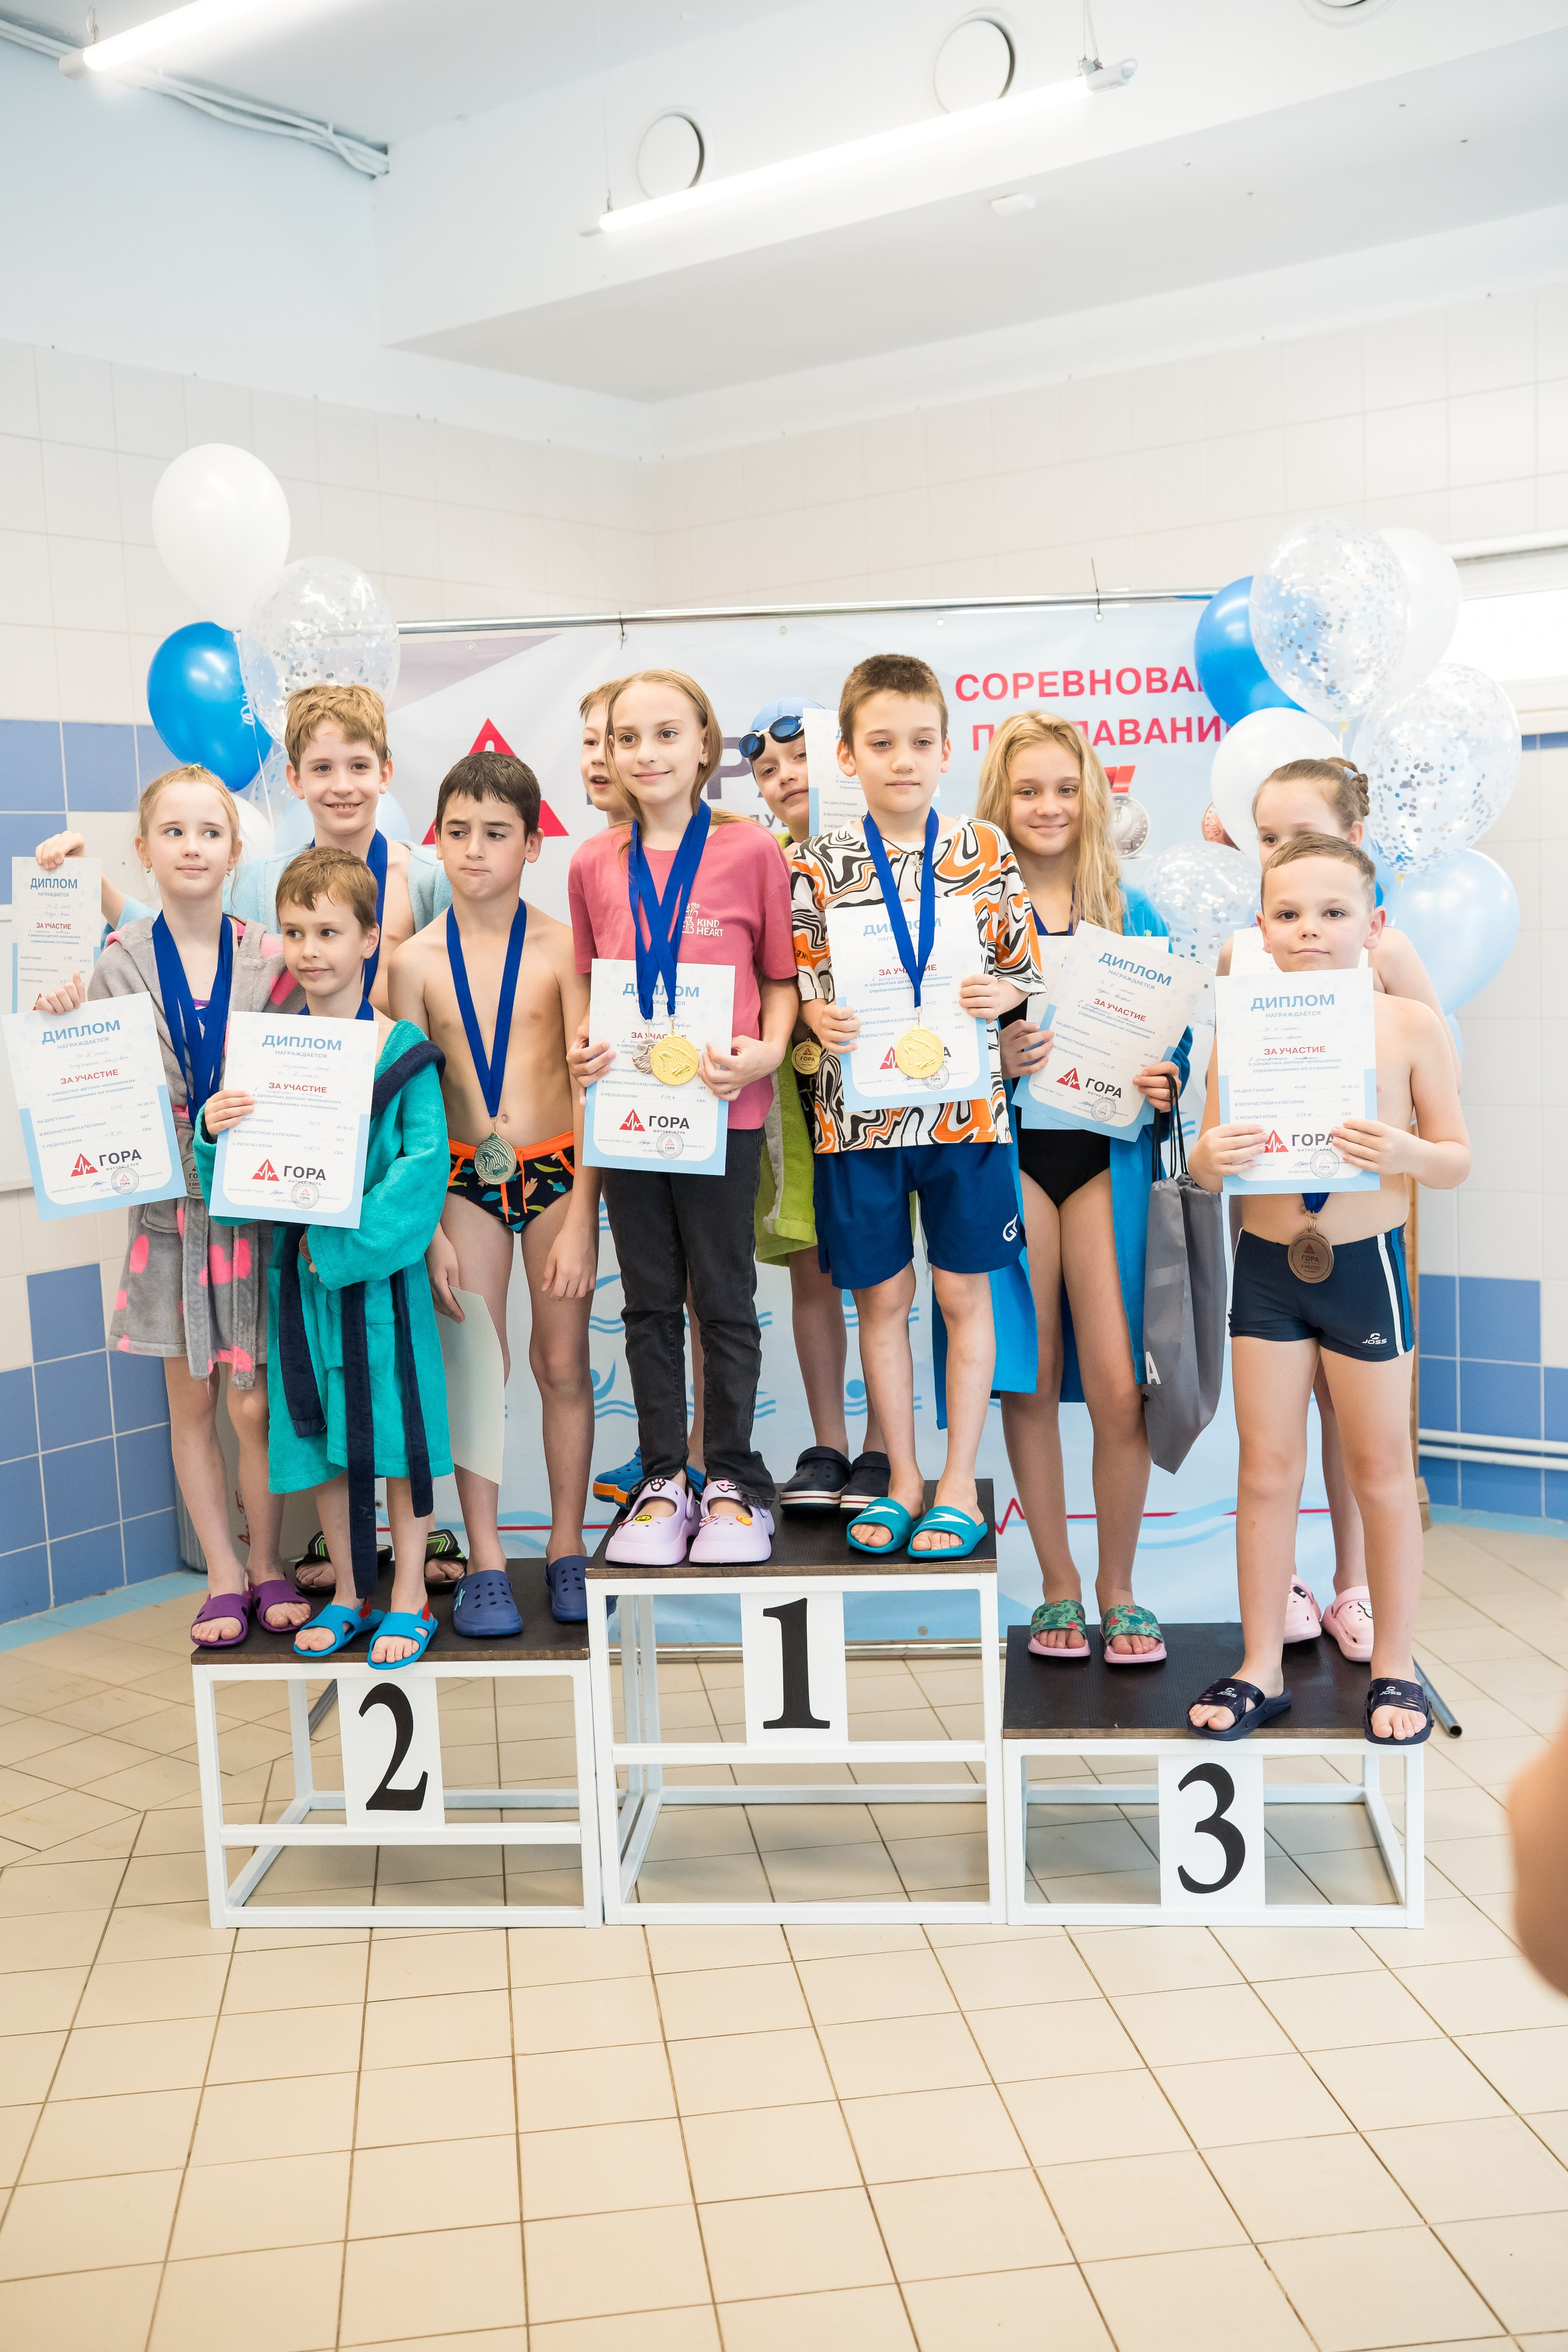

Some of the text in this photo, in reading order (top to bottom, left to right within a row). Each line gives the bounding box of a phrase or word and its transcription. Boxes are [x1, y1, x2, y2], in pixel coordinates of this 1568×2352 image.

[955, 666, 1205, 701] СОРЕВНОВА
[30, 878, 77, 889] ДИПЛОМ
[697, 919, 719, 928] KIND
[696, 927, 723, 937] HEART
[1098, 952, 1172, 986] ДИПЛОМ
[1109, 970, 1155, 990] НАГРАЖДАЕТСЯ
[1251, 993, 1335, 1011] ДИПЛОМ
[1094, 998, 1147, 1022] ЗА УЧАСТИЕ
[42, 1020, 121, 1045] ДИПЛОМ
[1062, 1023, 1090, 1036] ДИСТАНЦИИ
[1079, 1011, 1117, 1028] соревнованиях
[1125, 1028, 1150, 1039] плаванию
[58, 1037, 109, 1049] НАГРАЖДАЕТСЯ
[262, 1035, 342, 1050] ДИПЛОМ
[1055, 1033, 1111, 1057] ВОЗРАСТНОЙ КАТЕГОРИИ
[1280, 1046, 1326, 1055] УЧАСТИЕ
[75, 1069, 119, 1083] УЧАСТИЕ
[51, 1088, 80, 1096] закрытых
[80, 1079, 135, 1091] детско-юношеских
[284, 1084, 327, 1093] УЧАСТИЕ
[1085, 1077, 1122, 1098] ГОРА
[52, 1092, 97, 1102] соревнованиях
[285, 1096, 341, 1104] детско-юношеских
[44, 1114, 75, 1123] ДИСТАНЦИИ
[649, 1115, 690, 1129] ГОРА
[43, 1126, 77, 1136] ВОЗРАСТНОЙ
[77, 1121, 106, 1130] КАТЕГОРИИ
[47, 1139, 82, 1148] РЕЗУЛЬТАТОМ
[99, 1148, 142, 1166] ГОРА
[284, 1166, 326, 1181] ГОРА
[762, 1597, 831, 1730] 1
[358, 1682, 429, 1811] 2
[1177, 1762, 1246, 1894] 3
